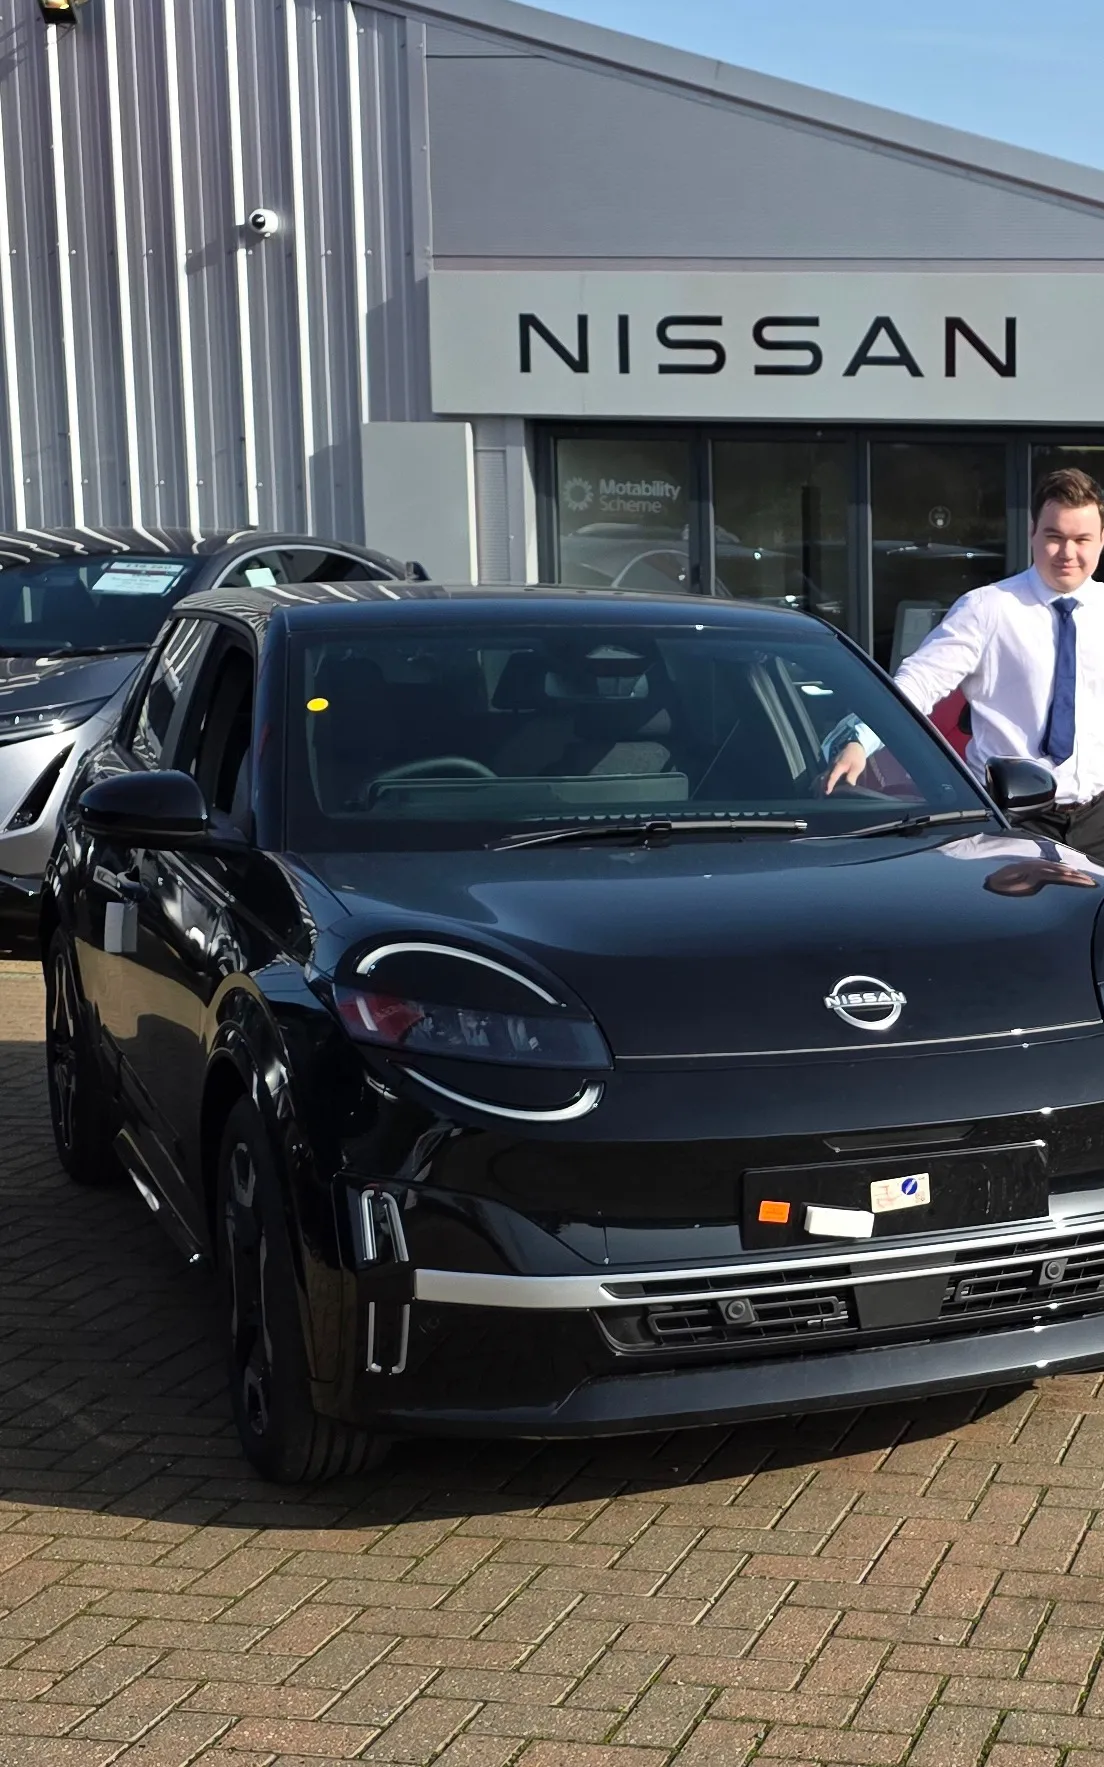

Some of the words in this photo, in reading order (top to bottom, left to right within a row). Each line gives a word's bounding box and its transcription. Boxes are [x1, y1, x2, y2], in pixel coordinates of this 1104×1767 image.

[518, 313, 1017, 378] NISSAN
[599, 479, 682, 501] Motability
[599, 495, 662, 514] Scheme
[824, 991, 907, 1009] NISSAN
